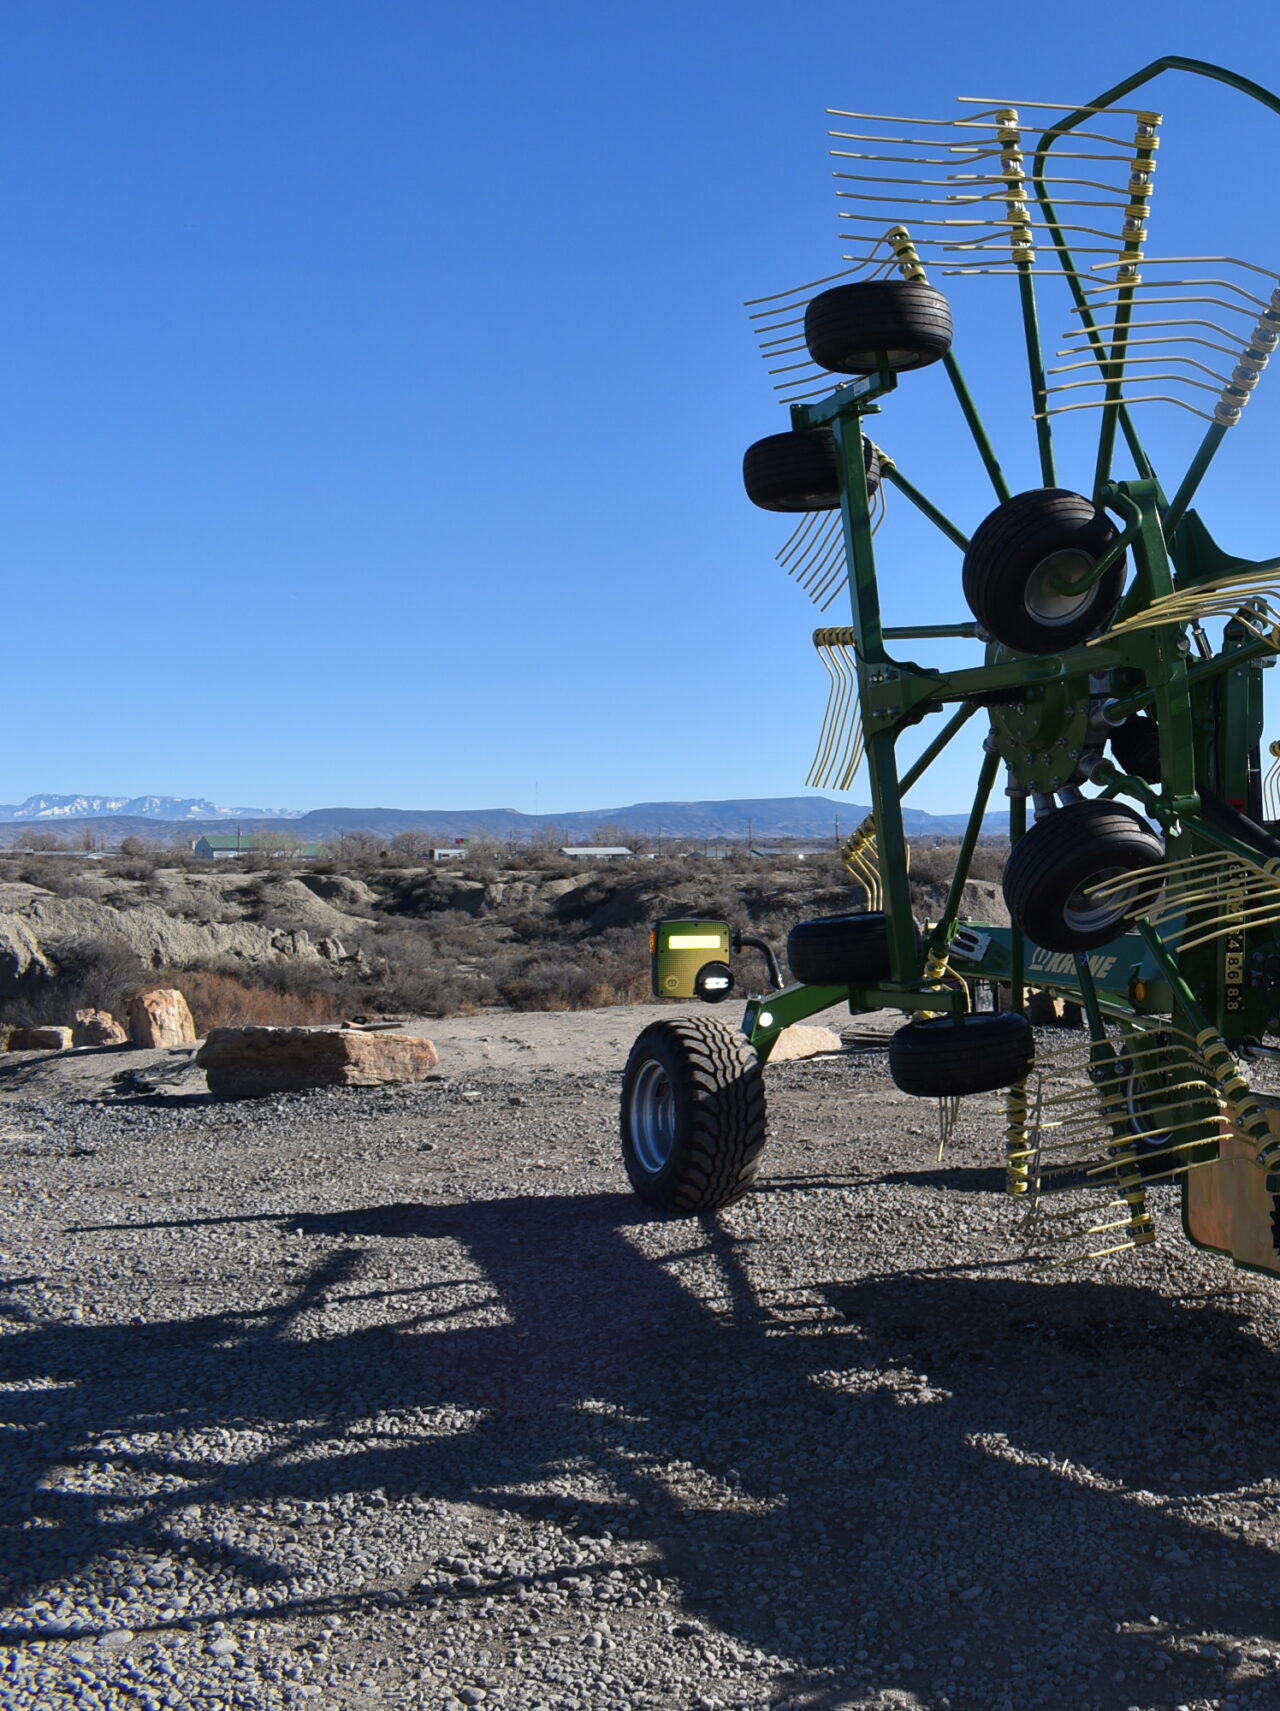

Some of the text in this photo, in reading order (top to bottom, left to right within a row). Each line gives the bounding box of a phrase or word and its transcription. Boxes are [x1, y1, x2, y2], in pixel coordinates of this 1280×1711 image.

[1045, 952, 1118, 978] KRNE
[1227, 957, 1239, 980] 8.6
[1227, 987, 1239, 1011] 8.8
